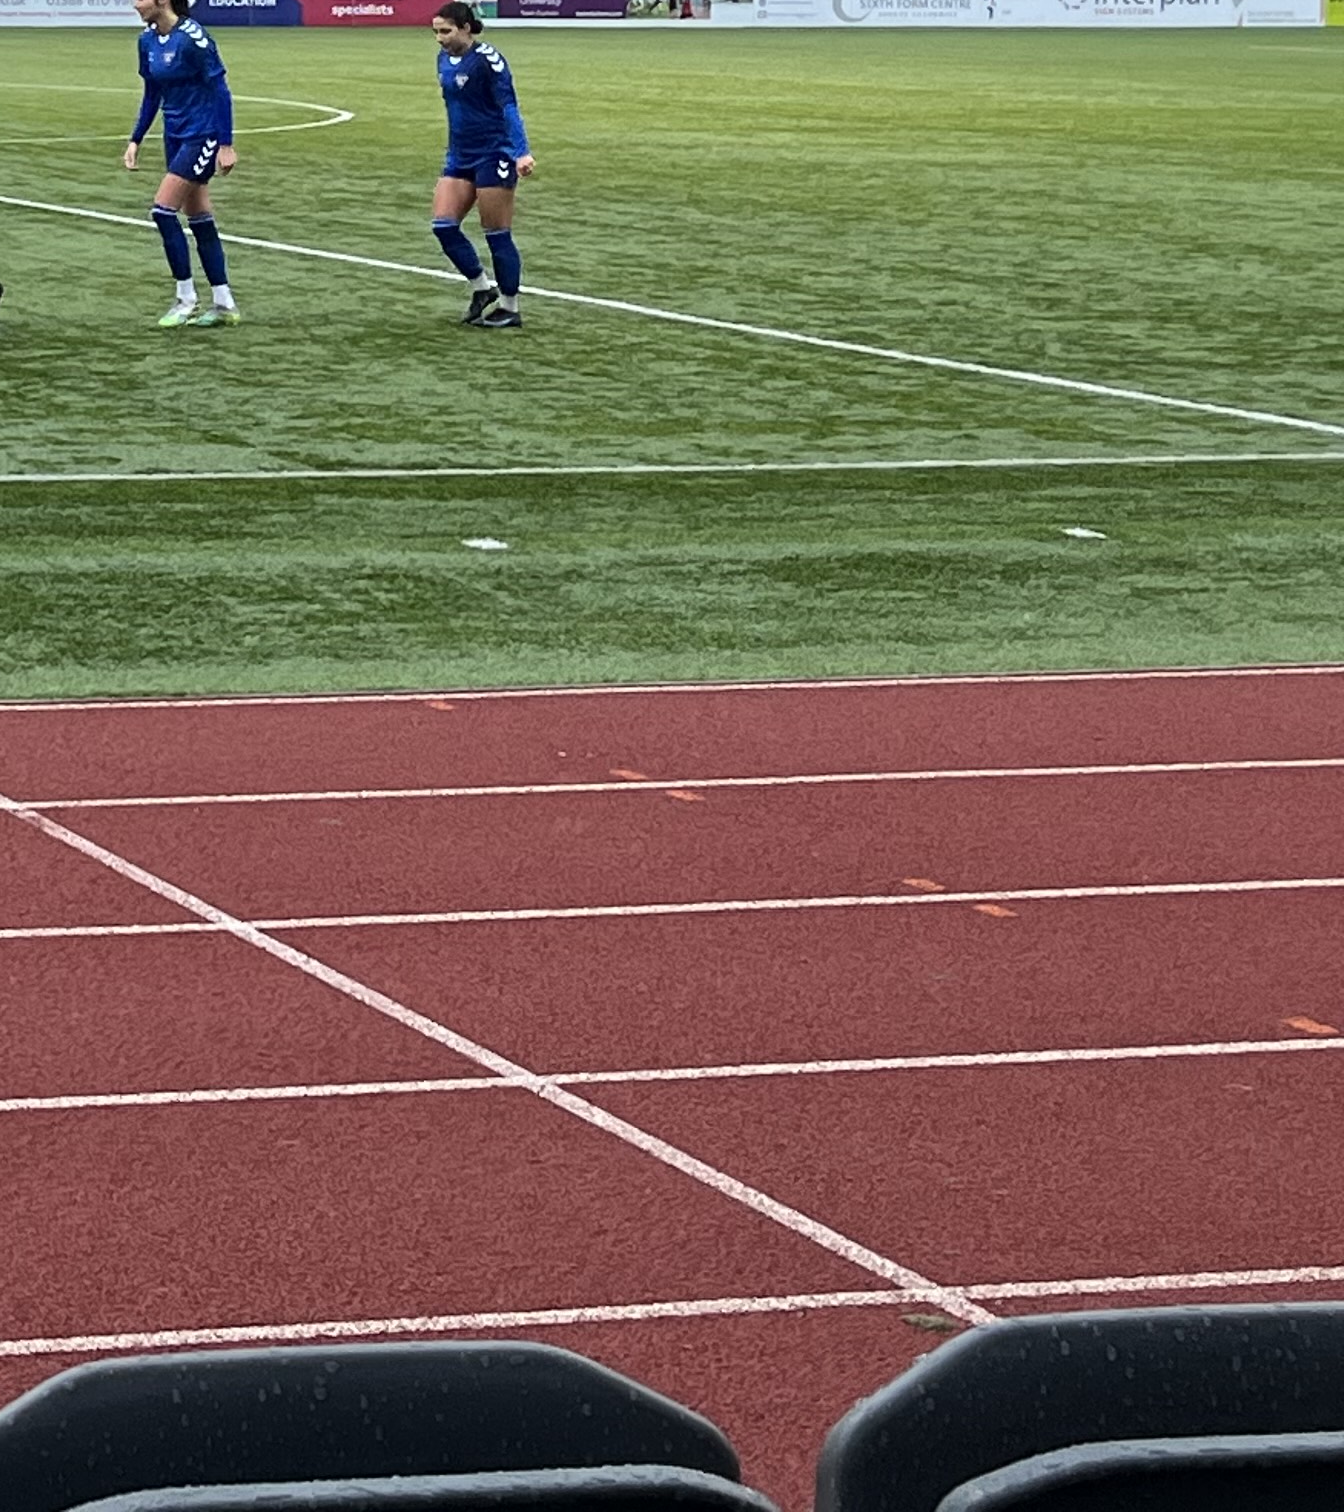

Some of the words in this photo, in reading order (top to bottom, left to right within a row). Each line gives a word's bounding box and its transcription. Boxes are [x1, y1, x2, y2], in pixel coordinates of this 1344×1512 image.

[859, 0, 893, 9] SIXTH
[896, 0, 929, 9] FORM
[931, 0, 972, 9] CENTRE
[330, 4, 394, 17] specialists
